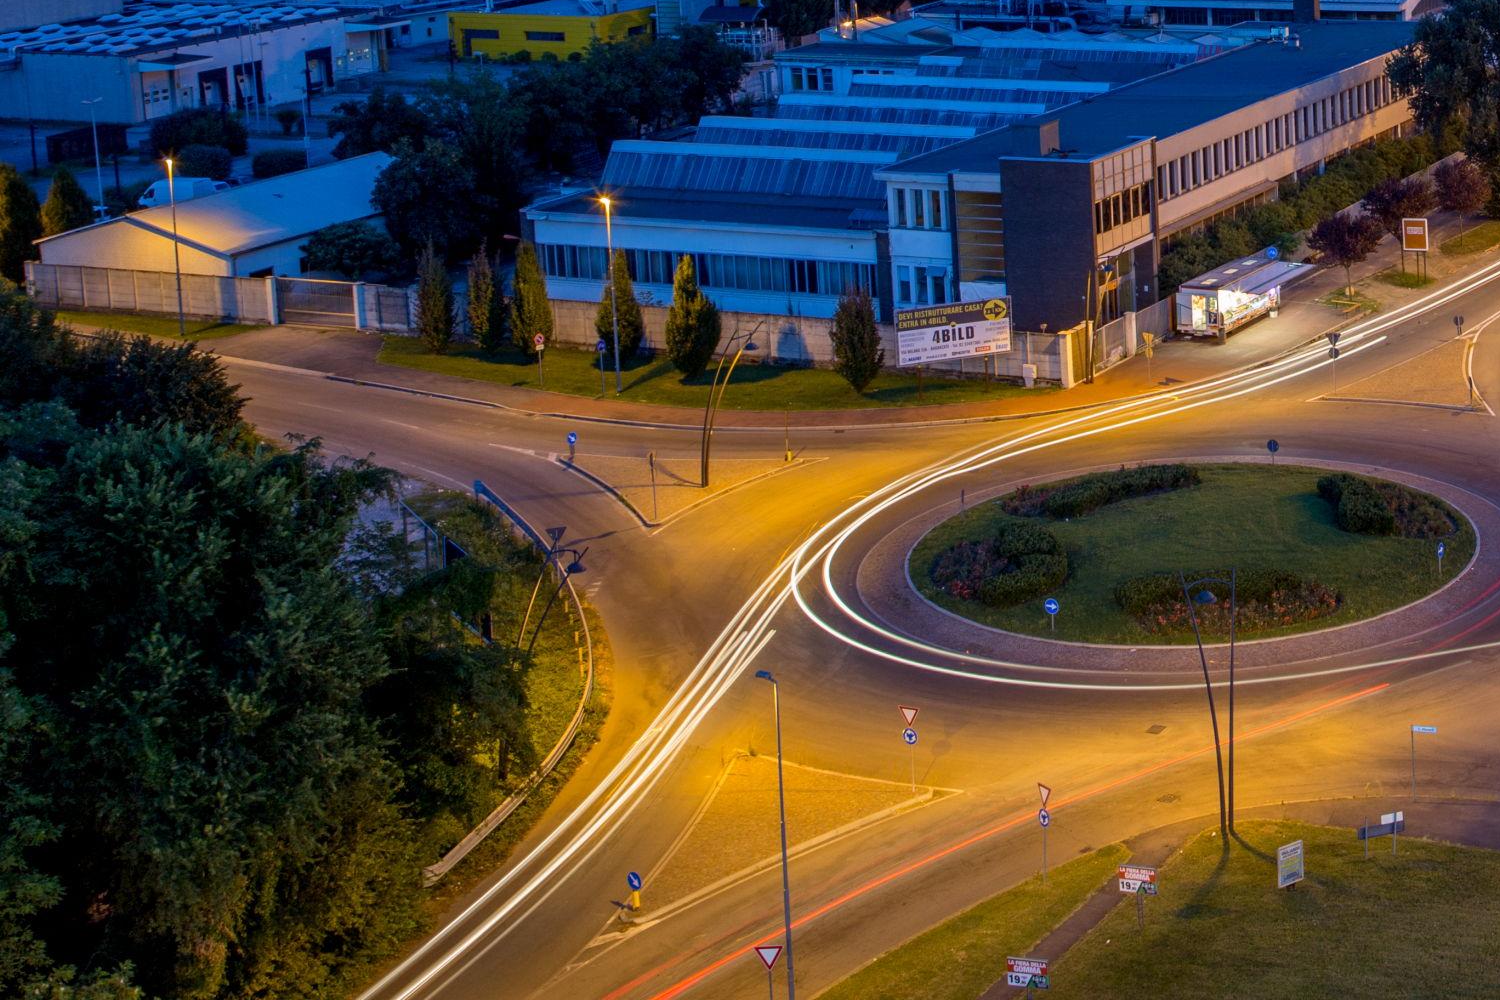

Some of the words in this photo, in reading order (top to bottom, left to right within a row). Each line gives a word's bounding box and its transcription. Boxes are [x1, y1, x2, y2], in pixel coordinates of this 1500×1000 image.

[899, 312, 913, 320] DEVI
[914, 305, 963, 319] RISTRUTTURARE
[1124, 872, 1150, 881] GOMMA
[1014, 966, 1041, 974] GOMMA
